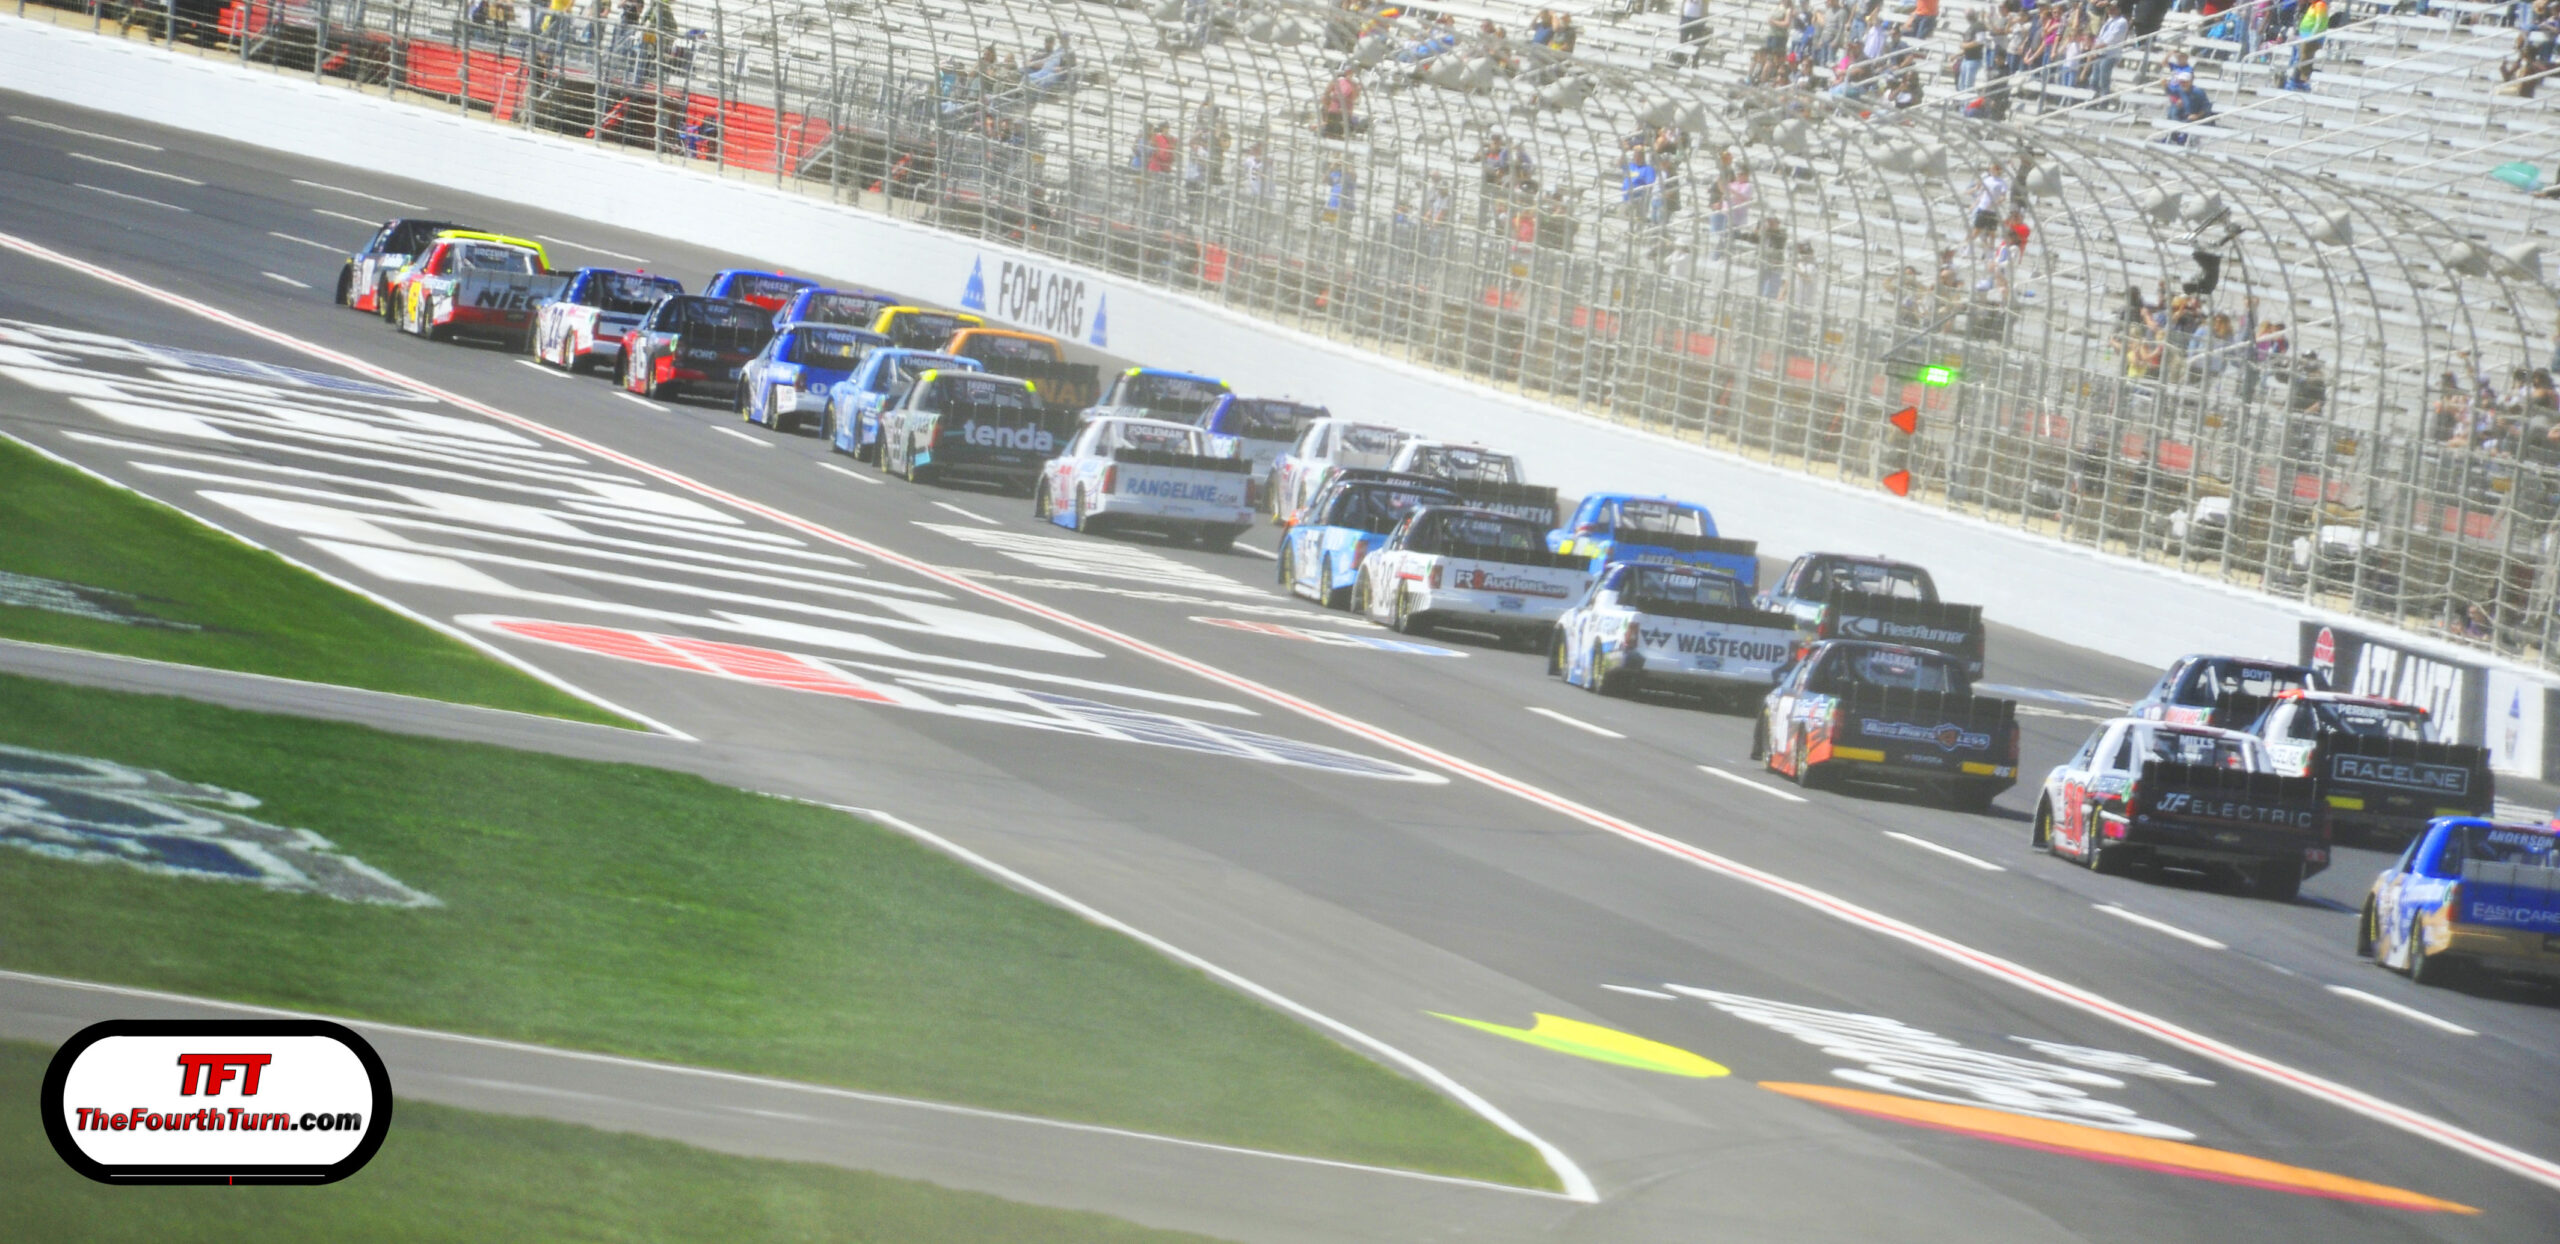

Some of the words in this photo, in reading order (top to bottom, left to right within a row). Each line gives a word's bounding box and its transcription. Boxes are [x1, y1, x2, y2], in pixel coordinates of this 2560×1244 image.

[475, 288, 544, 312] NIEC
[998, 261, 1085, 338] FOH.ORG
[964, 419, 1054, 451] tenda
[2241, 668, 2272, 681] BOYD
[2340, 759, 2462, 790] RACELINE
[2191, 800, 2313, 827] ELECTRIC
[2487, 830, 2555, 848] ANDERSON
